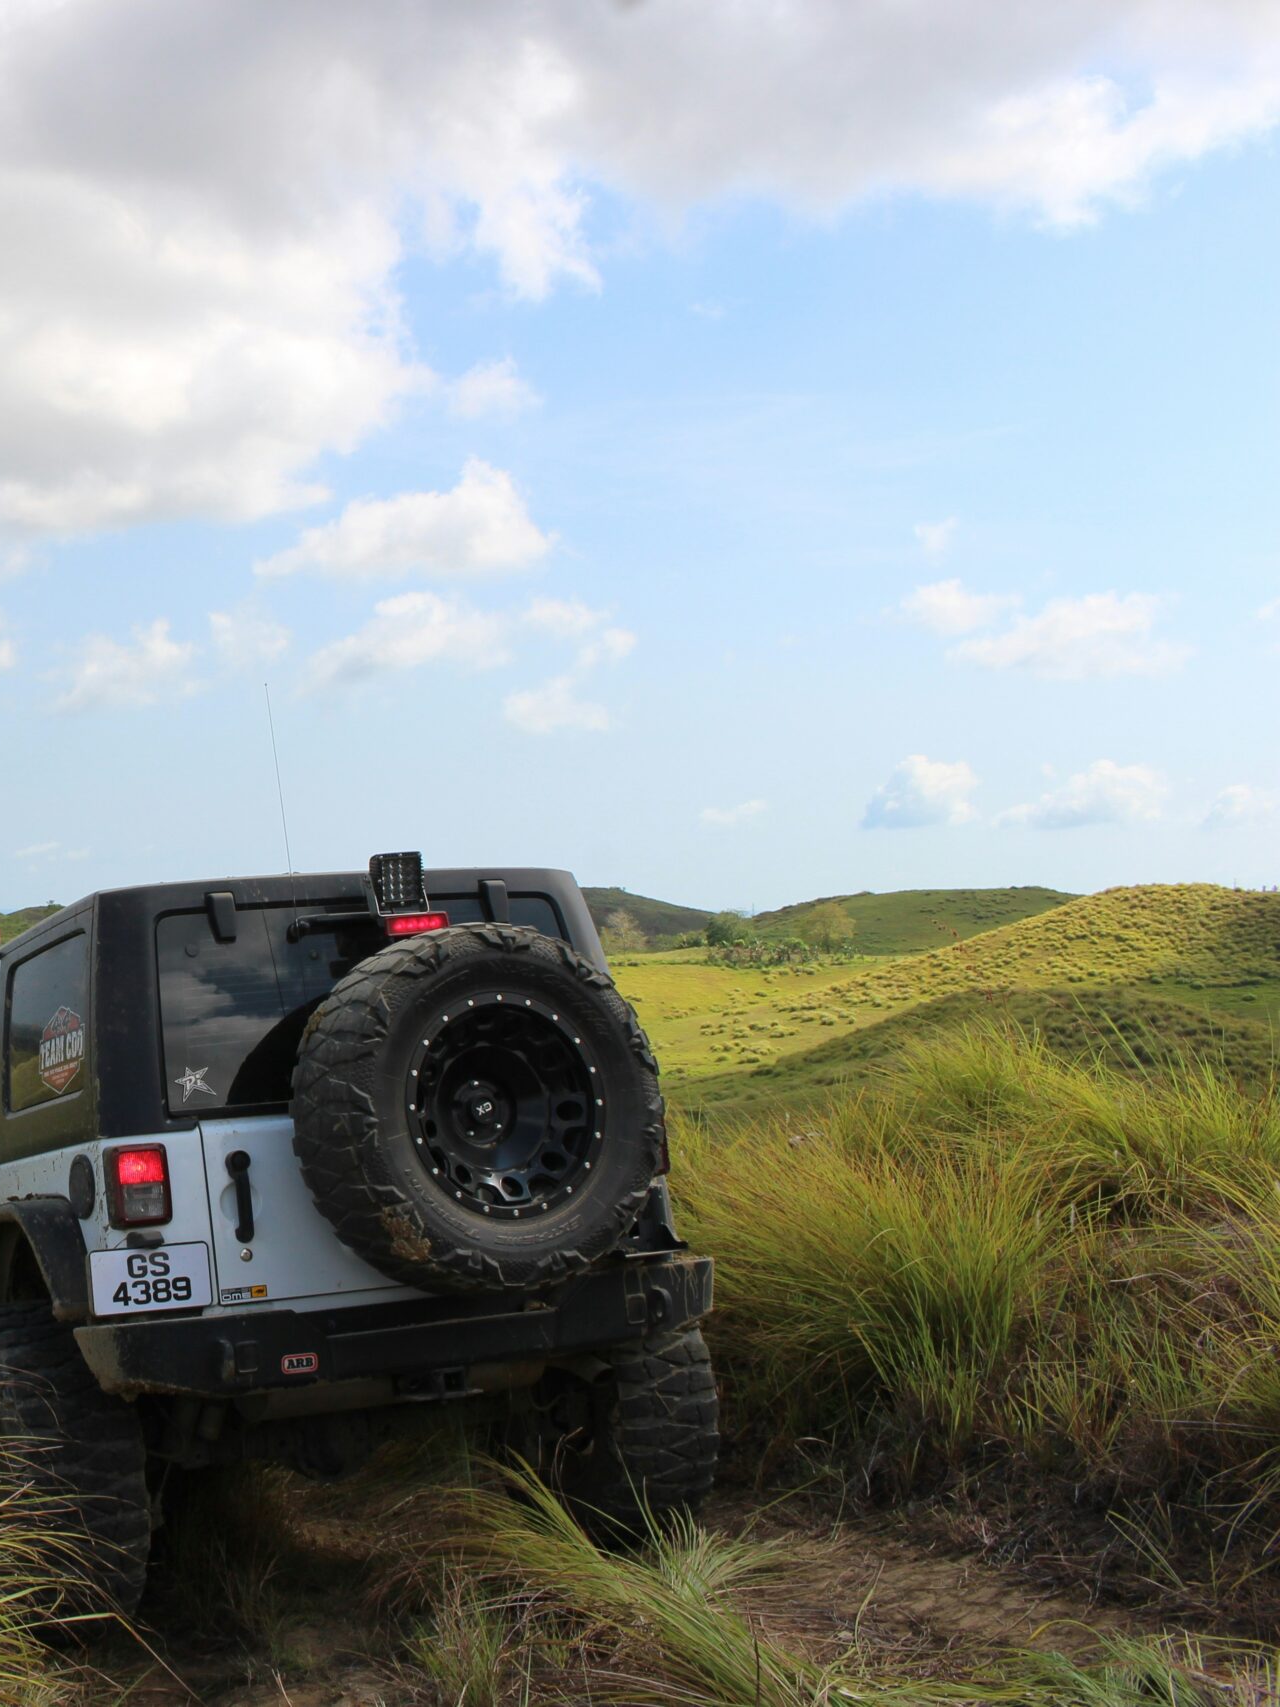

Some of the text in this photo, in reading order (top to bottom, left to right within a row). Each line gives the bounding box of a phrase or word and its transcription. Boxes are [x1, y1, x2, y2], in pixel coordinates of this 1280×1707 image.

[40, 1035, 64, 1070] TEAM
[126, 1252, 171, 1278] GS
[113, 1276, 192, 1306] 4389
[287, 1357, 314, 1369] ARB
